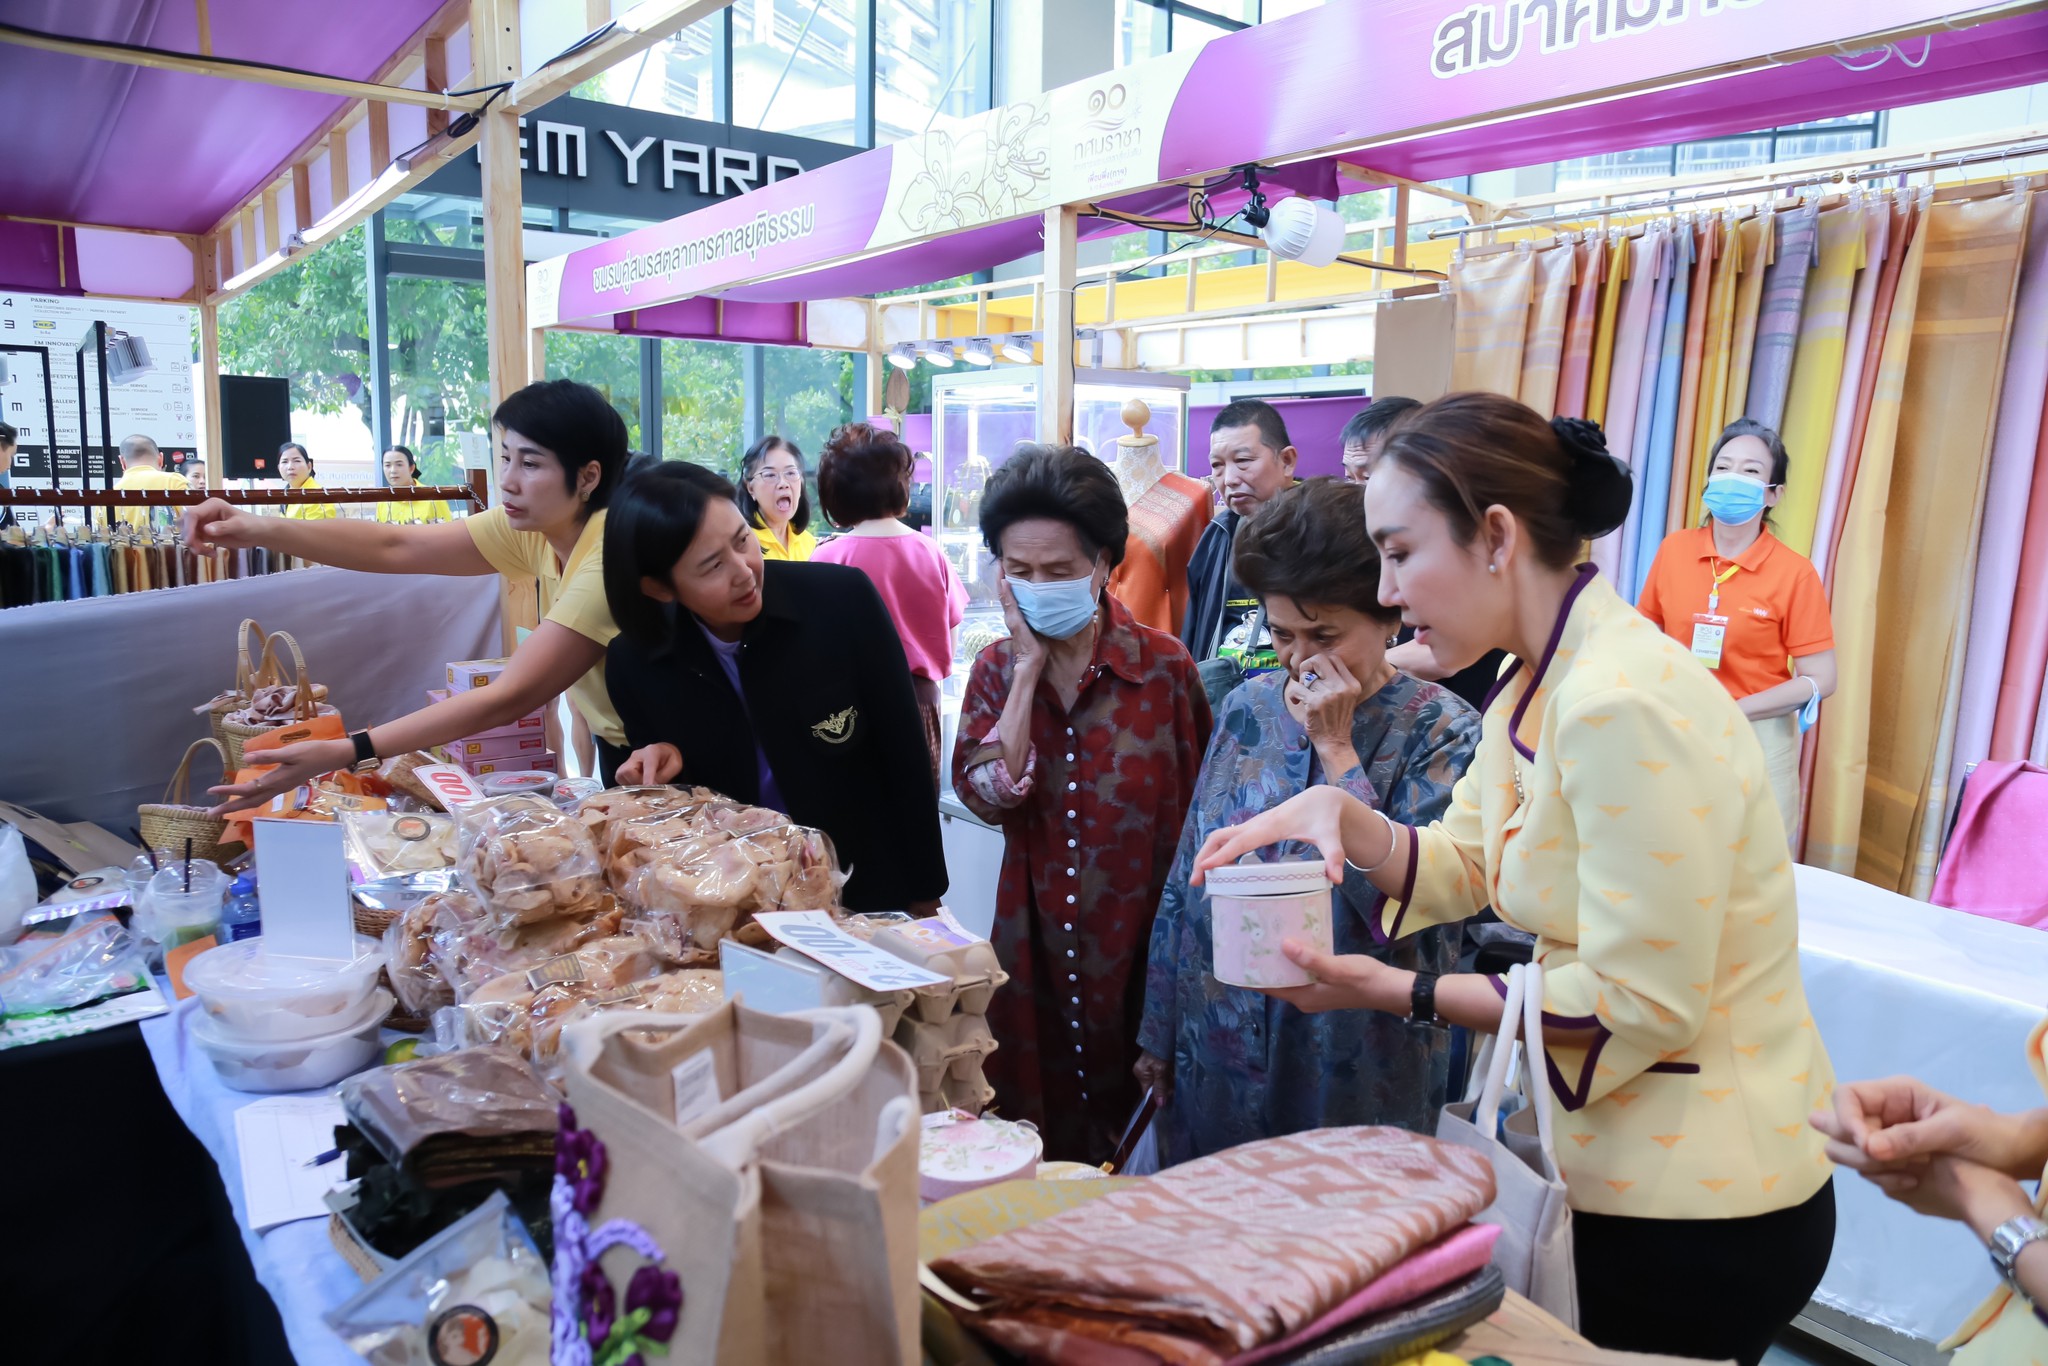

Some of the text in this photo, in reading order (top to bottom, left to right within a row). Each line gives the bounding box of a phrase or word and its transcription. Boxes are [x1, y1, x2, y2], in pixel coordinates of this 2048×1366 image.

[477, 116, 587, 177] M
[593, 205, 814, 294] ชมรมคู่สมรสตุลาการศาลยุติธรรม
[2, 298, 13, 307] 4
[4, 319, 15, 329] 3
[14, 453, 30, 467] G
